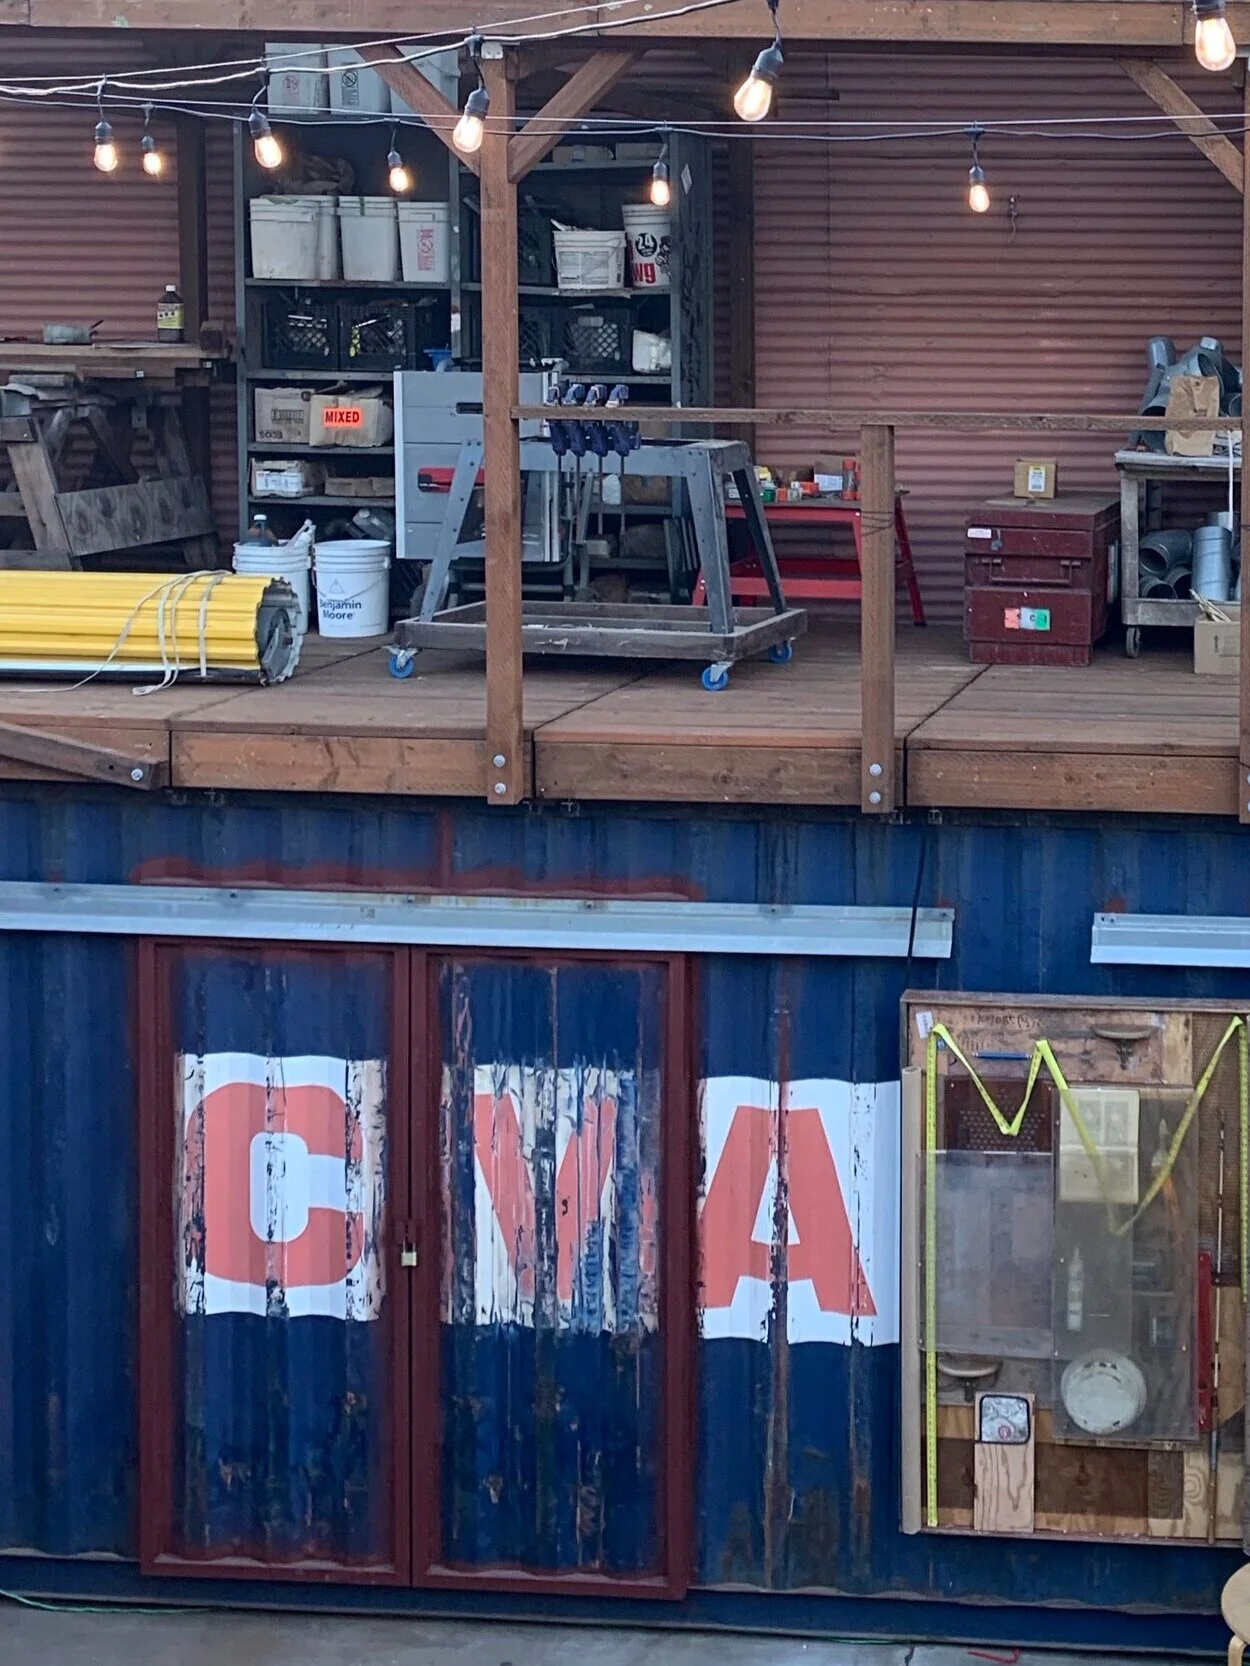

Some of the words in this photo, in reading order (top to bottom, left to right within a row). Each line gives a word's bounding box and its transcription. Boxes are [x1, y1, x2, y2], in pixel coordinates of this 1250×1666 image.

[637, 234, 654, 250] 24
[325, 411, 360, 424] MIXED
[319, 599, 362, 611] Benjamin
[322, 610, 354, 620] Moore
